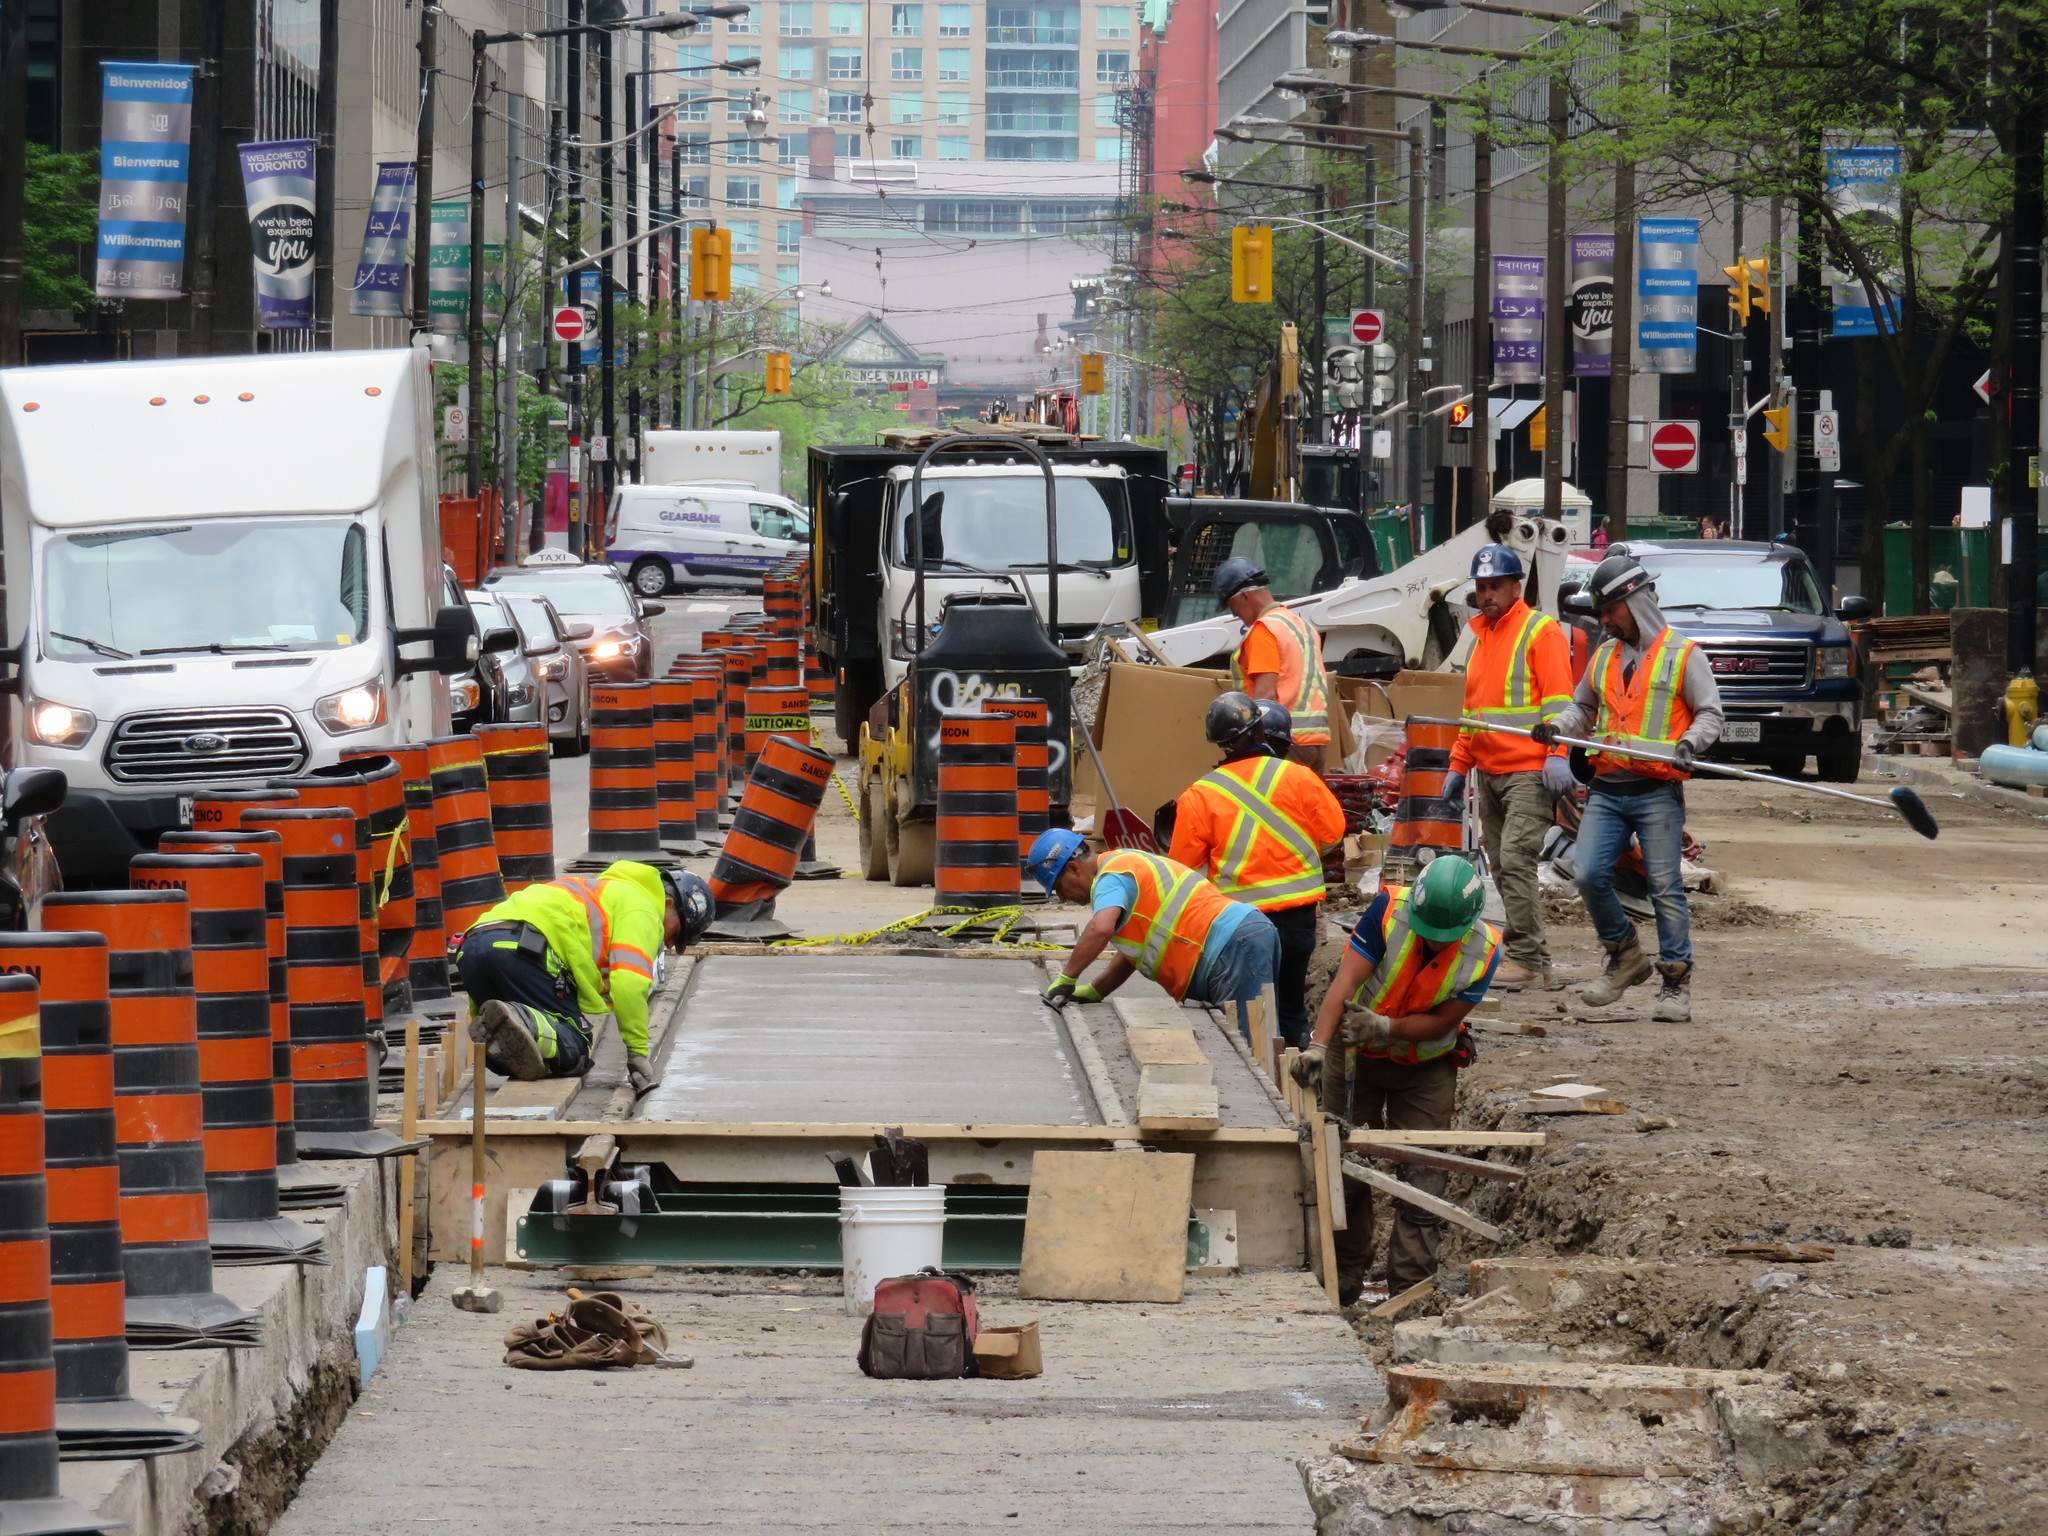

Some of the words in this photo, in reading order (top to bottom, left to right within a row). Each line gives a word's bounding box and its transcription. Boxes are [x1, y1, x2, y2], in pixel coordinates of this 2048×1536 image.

[109, 76, 188, 89] Bienvenidos
[113, 156, 180, 168] Bienvenue
[246, 151, 293, 163] WELCOME
[294, 150, 307, 159] TO
[248, 159, 307, 173] TORONTO
[257, 217, 287, 228] we've
[289, 216, 313, 227] been
[267, 227, 313, 238] expecting
[103, 234, 182, 248] Willkommen
[268, 239, 309, 272] you
[1576, 249, 1615, 257] TORONT
[1646, 279, 1691, 287] Bienvenue
[1577, 292, 1600, 300] we've
[1581, 308, 1613, 335] you
[1641, 331, 1694, 339] Willkommen
[1497, 346, 1537, 358] ようこそ
[658, 511, 721, 523] GEARBANK
[538, 553, 566, 562] TAXI
[1711, 658, 1770, 672] GMC
[193, 737, 218, 749] Ford
